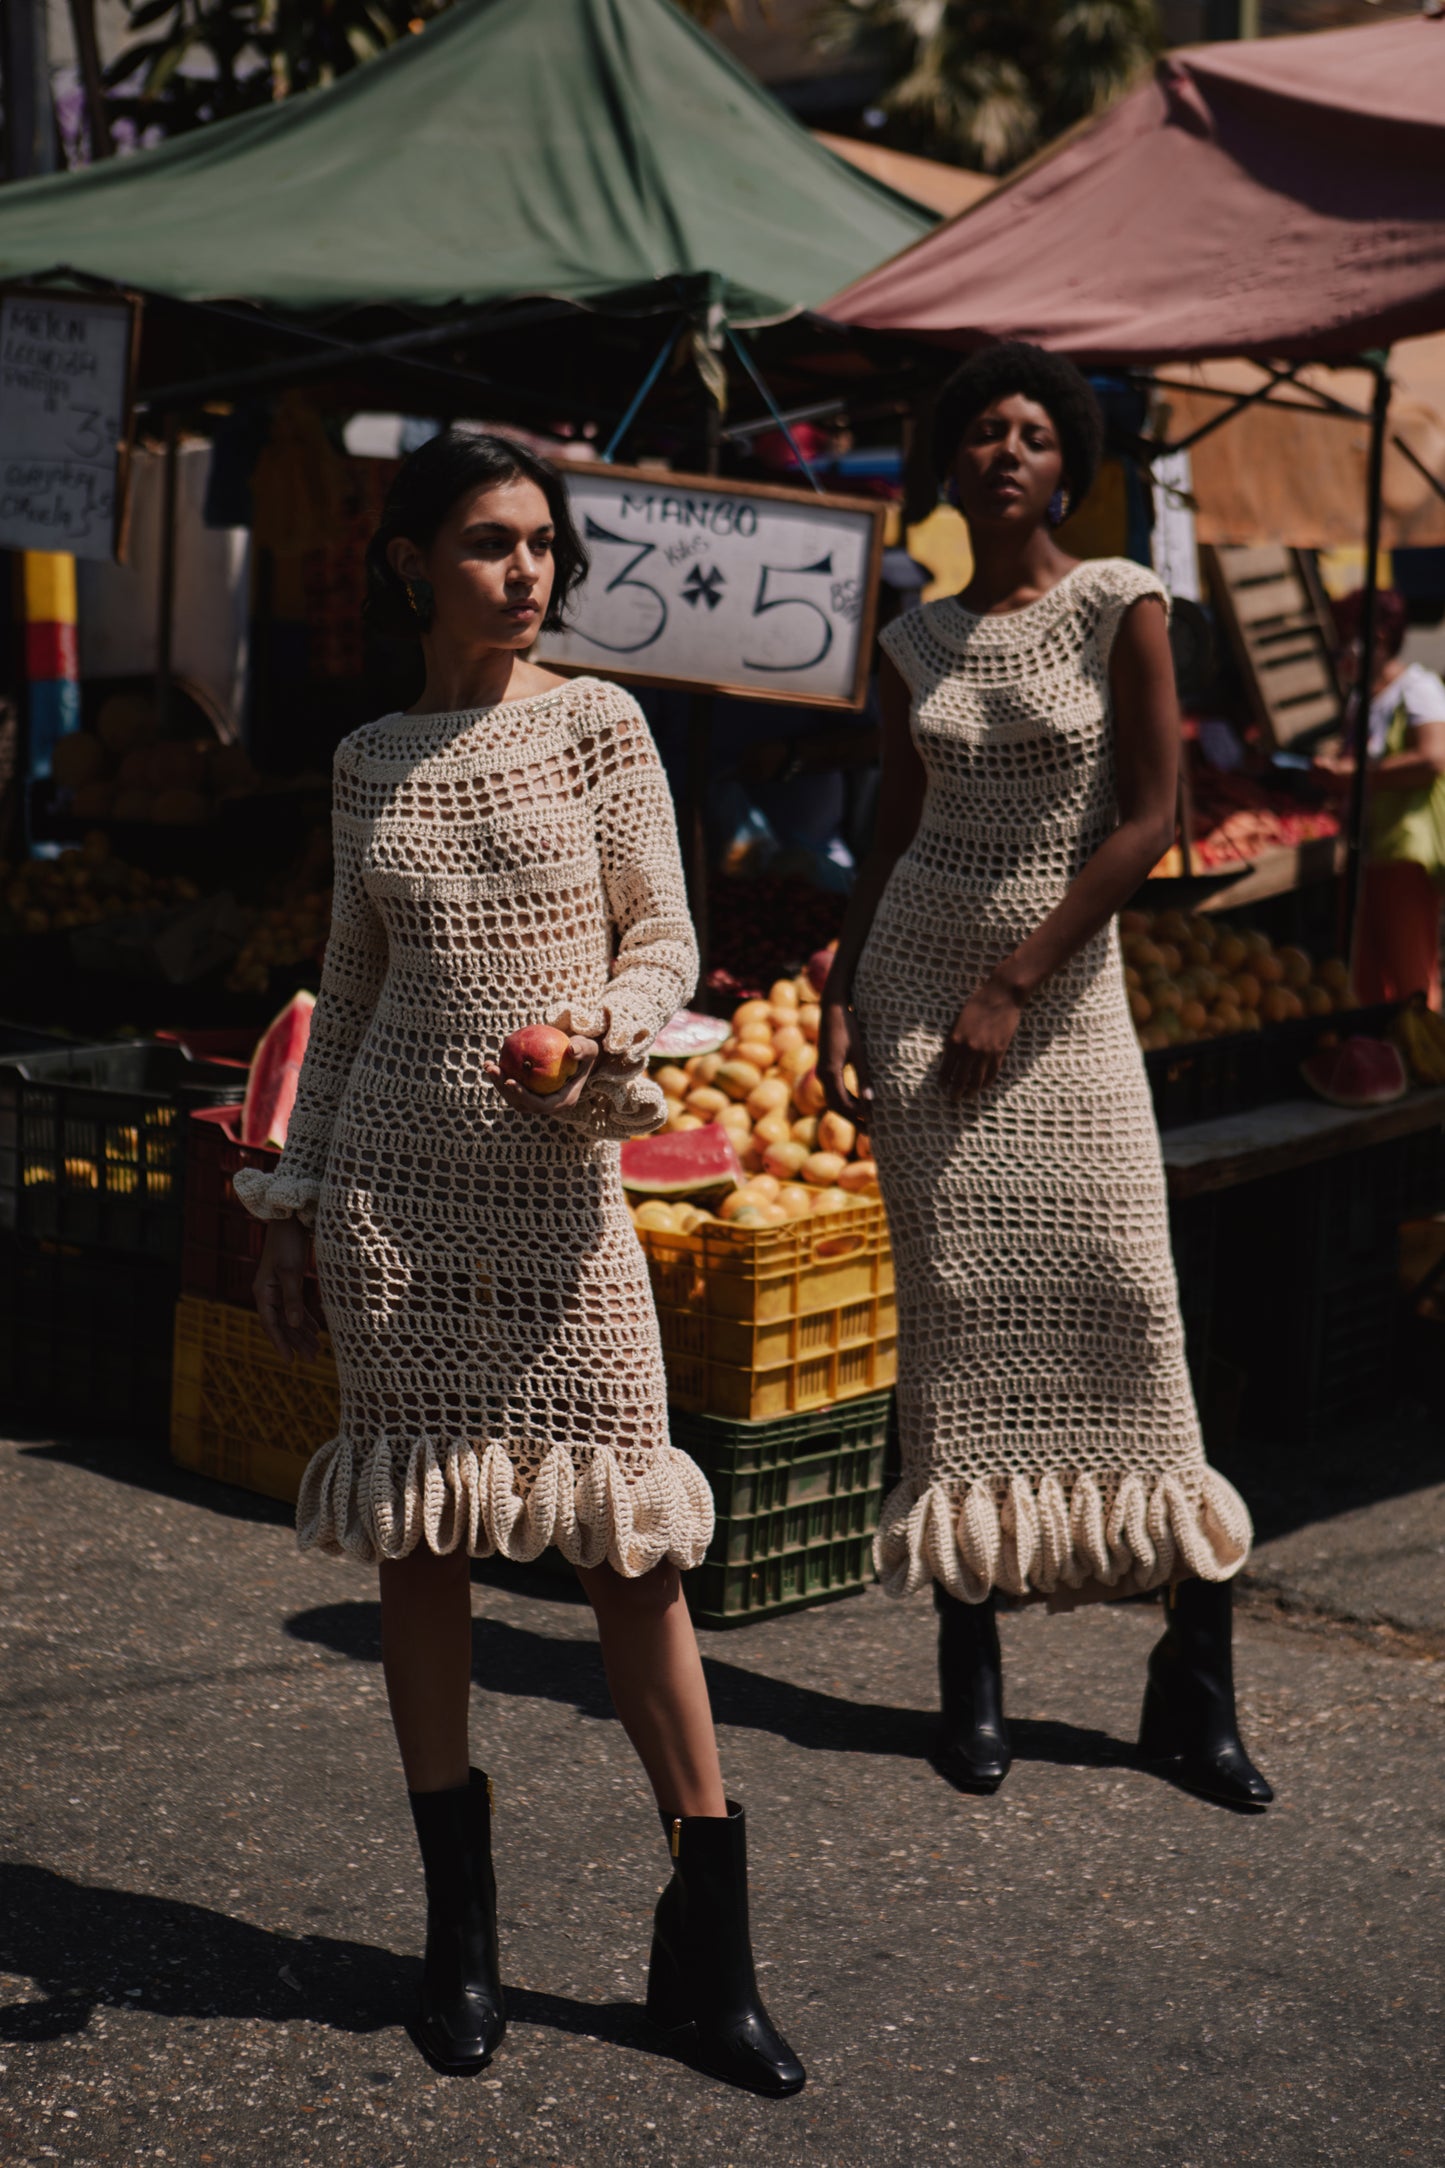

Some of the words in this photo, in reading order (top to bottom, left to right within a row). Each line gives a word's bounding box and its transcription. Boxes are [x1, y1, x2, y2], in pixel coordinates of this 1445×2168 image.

[65, 403, 104, 458] 3
[620, 494, 759, 537] MANGO
[566, 514, 669, 654] 3
[742, 552, 834, 672] 5
